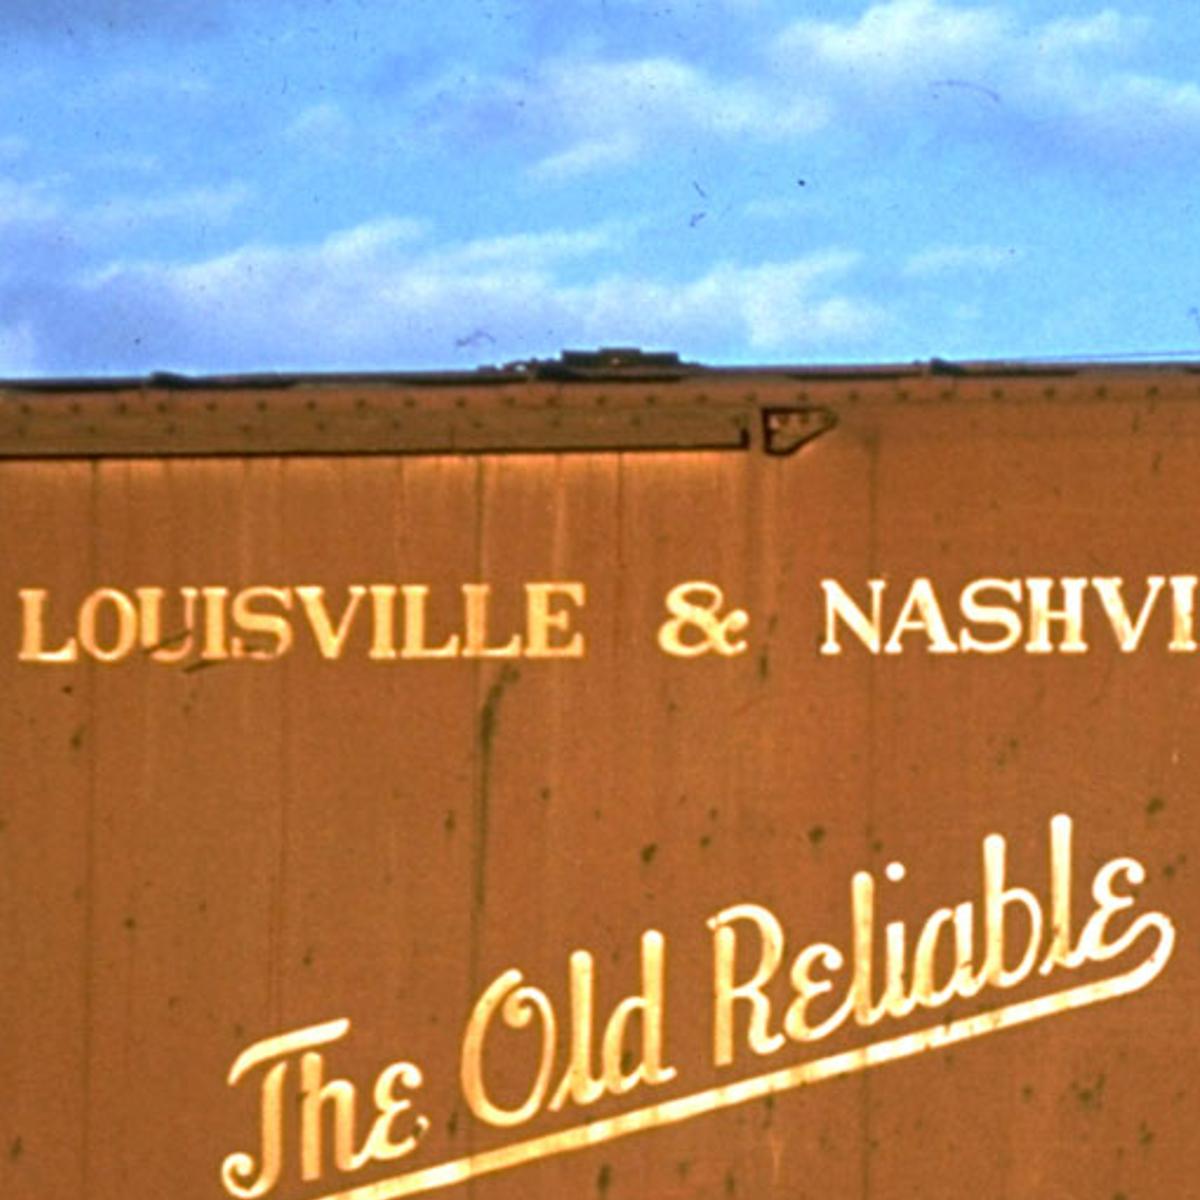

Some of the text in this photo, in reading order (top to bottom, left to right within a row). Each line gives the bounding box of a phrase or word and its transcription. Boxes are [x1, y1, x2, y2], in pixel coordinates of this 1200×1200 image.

[18, 582, 586, 663] LOUISVILLE
[657, 581, 749, 657] &
[220, 813, 1176, 1200] The Old Reliable
